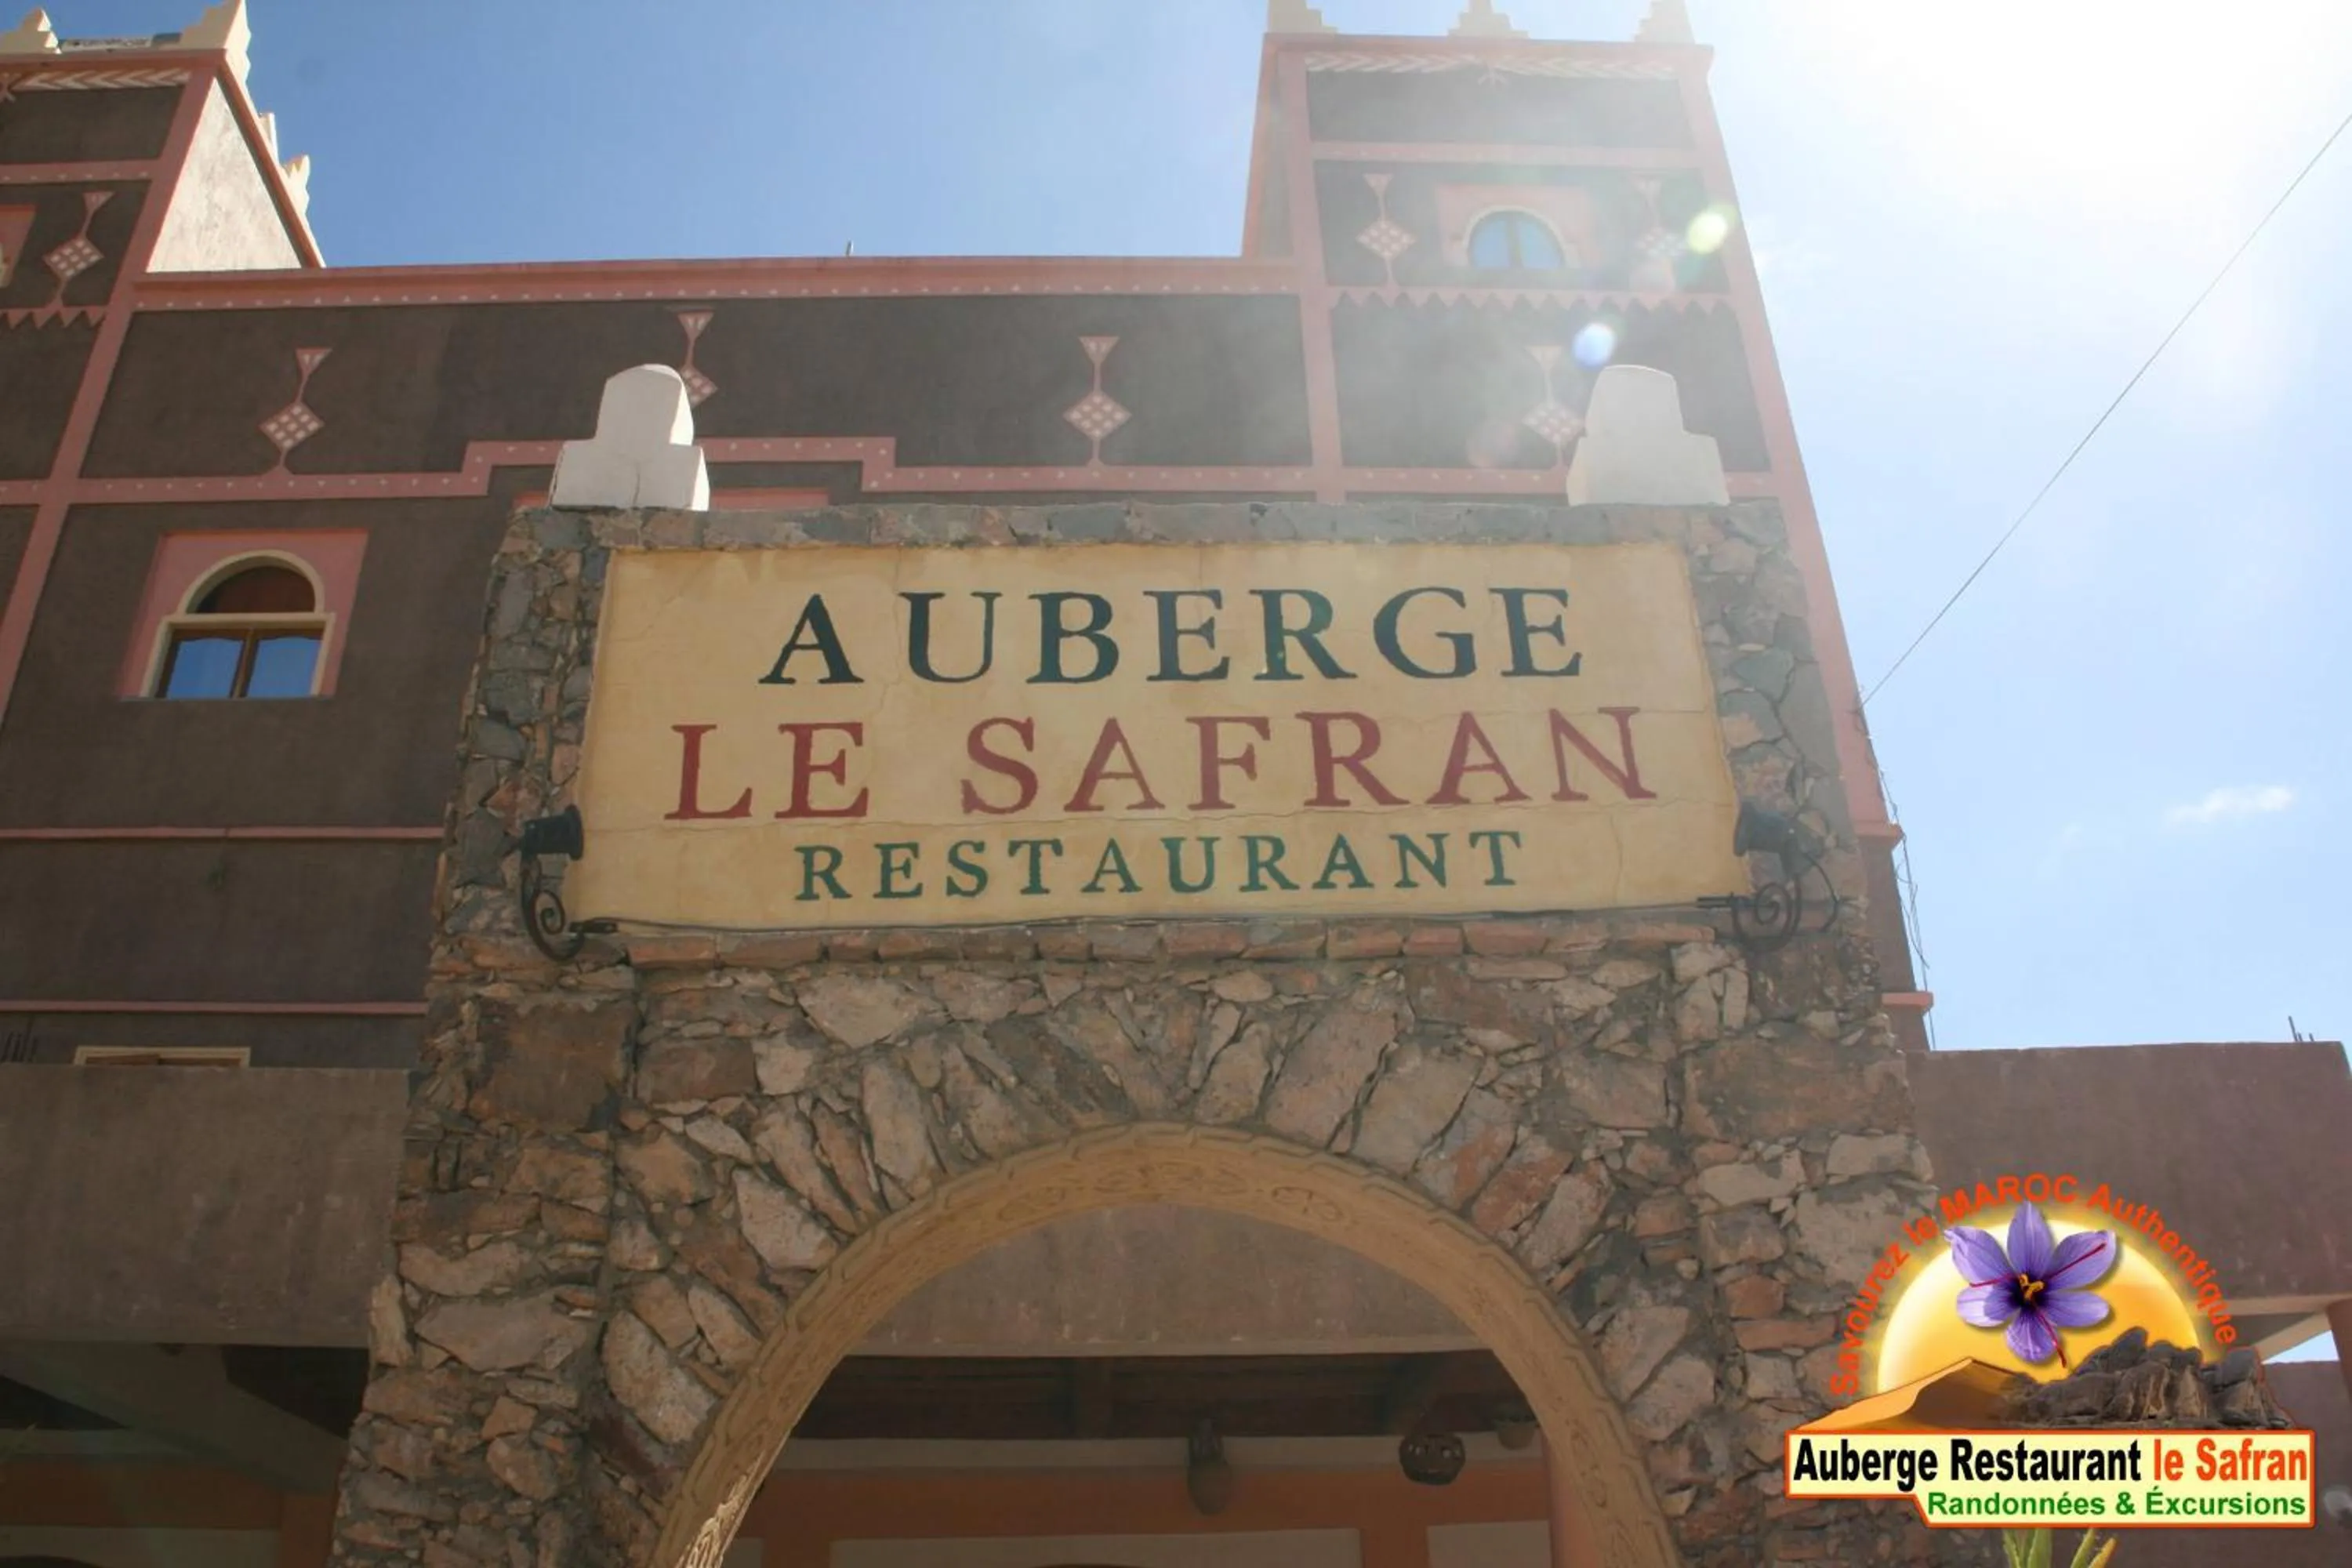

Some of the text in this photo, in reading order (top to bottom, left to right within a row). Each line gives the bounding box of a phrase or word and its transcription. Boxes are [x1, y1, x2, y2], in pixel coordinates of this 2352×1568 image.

[758, 586, 1582, 684] AUBERGE
[664, 706, 1657, 820] LE SAFRAN
[794, 830, 1522, 901] RESTAURANT
